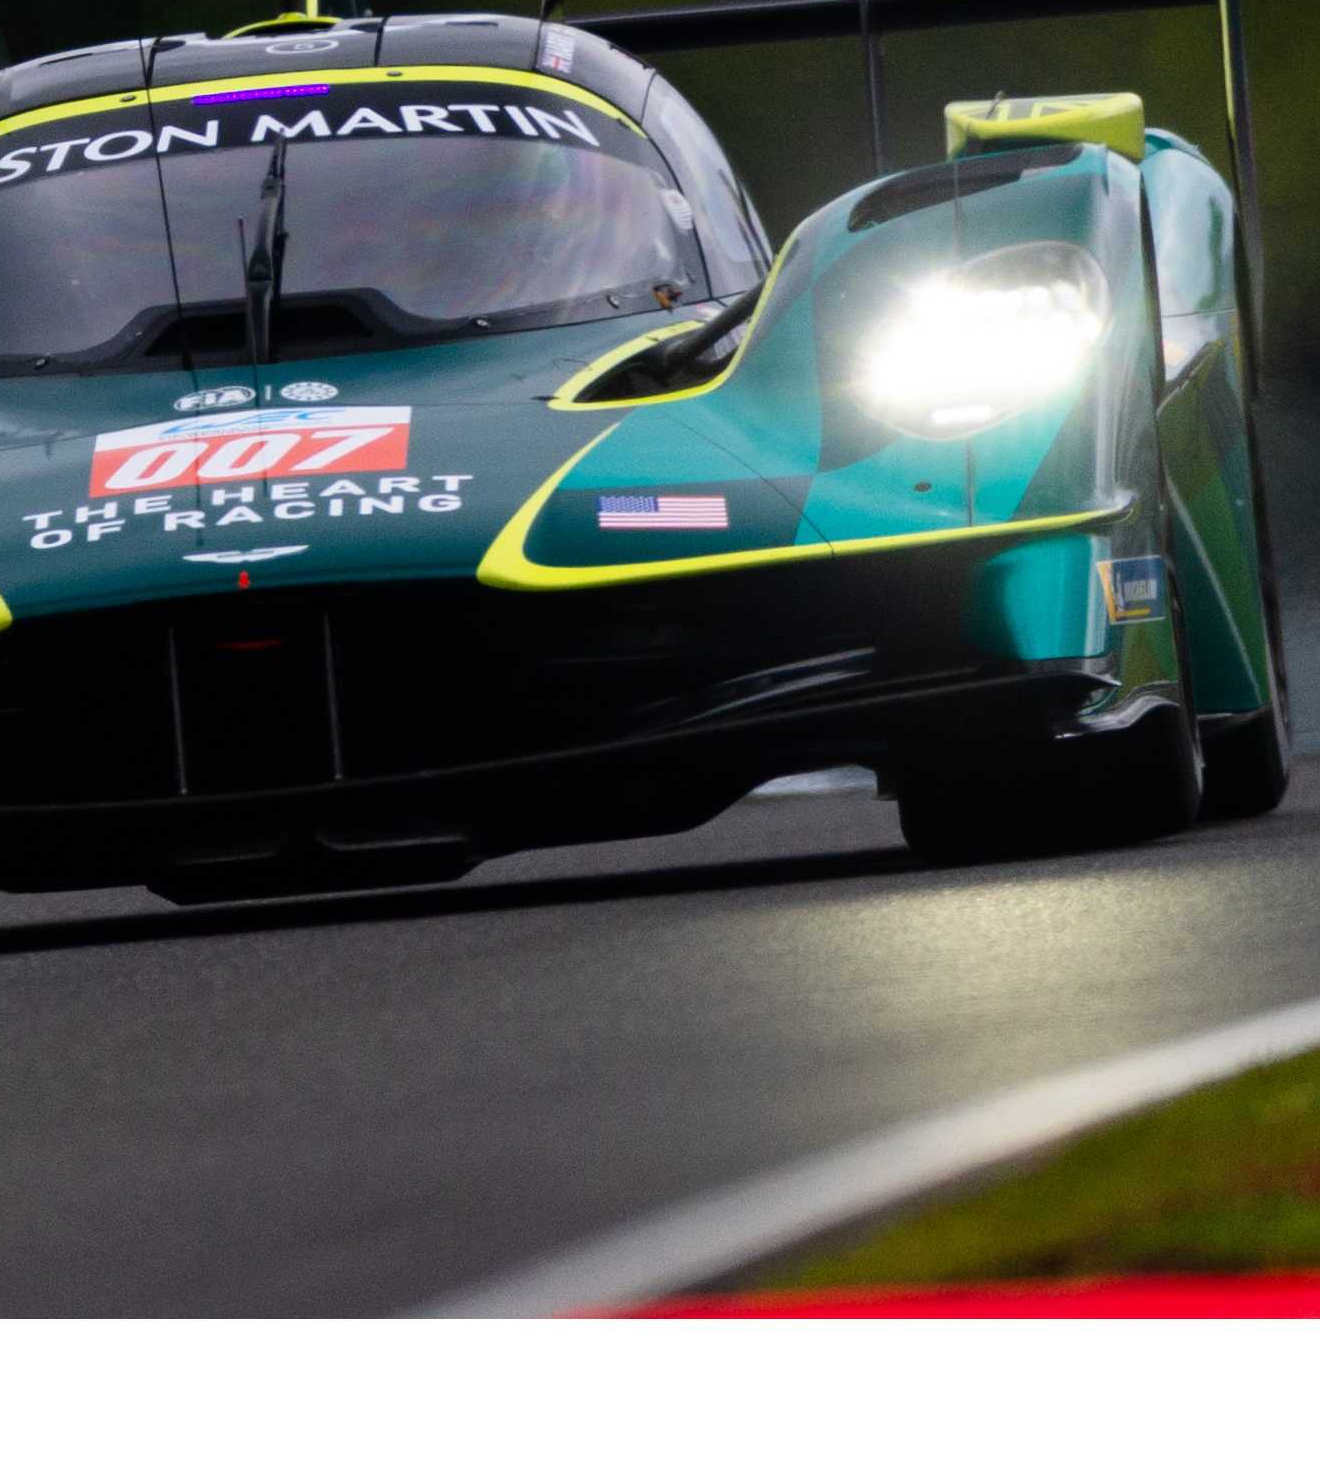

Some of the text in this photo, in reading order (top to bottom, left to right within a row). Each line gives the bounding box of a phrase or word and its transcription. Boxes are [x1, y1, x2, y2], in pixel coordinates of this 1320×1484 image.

[250, 104, 601, 147] MARTIN
[176, 388, 247, 410] FIA
[104, 426, 394, 490] 007
[22, 474, 474, 530] THE HEART
[29, 494, 463, 550] OF RACING
